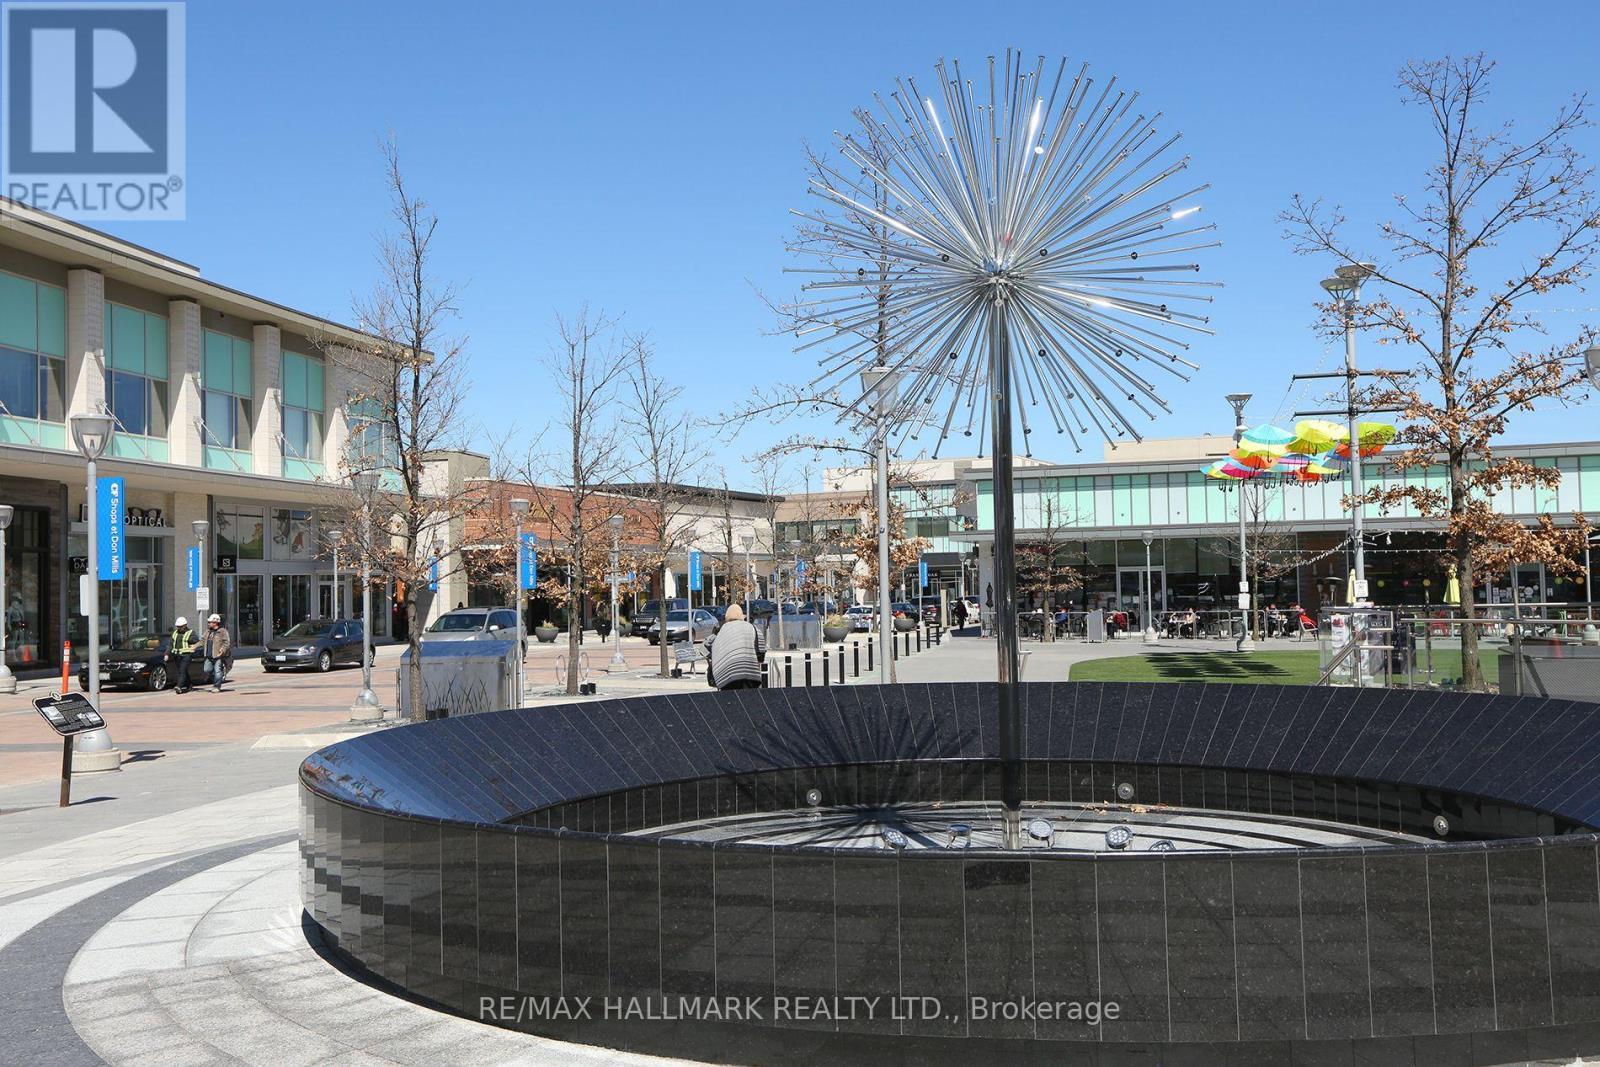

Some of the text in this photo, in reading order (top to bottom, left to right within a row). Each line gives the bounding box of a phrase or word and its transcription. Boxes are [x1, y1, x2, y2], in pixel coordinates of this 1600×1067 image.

[110, 498, 119, 524] Shops
[111, 526, 119, 534] at
[124, 516, 167, 527] OPTICAL
[111, 536, 119, 553] Don
[111, 555, 119, 574] Mills
